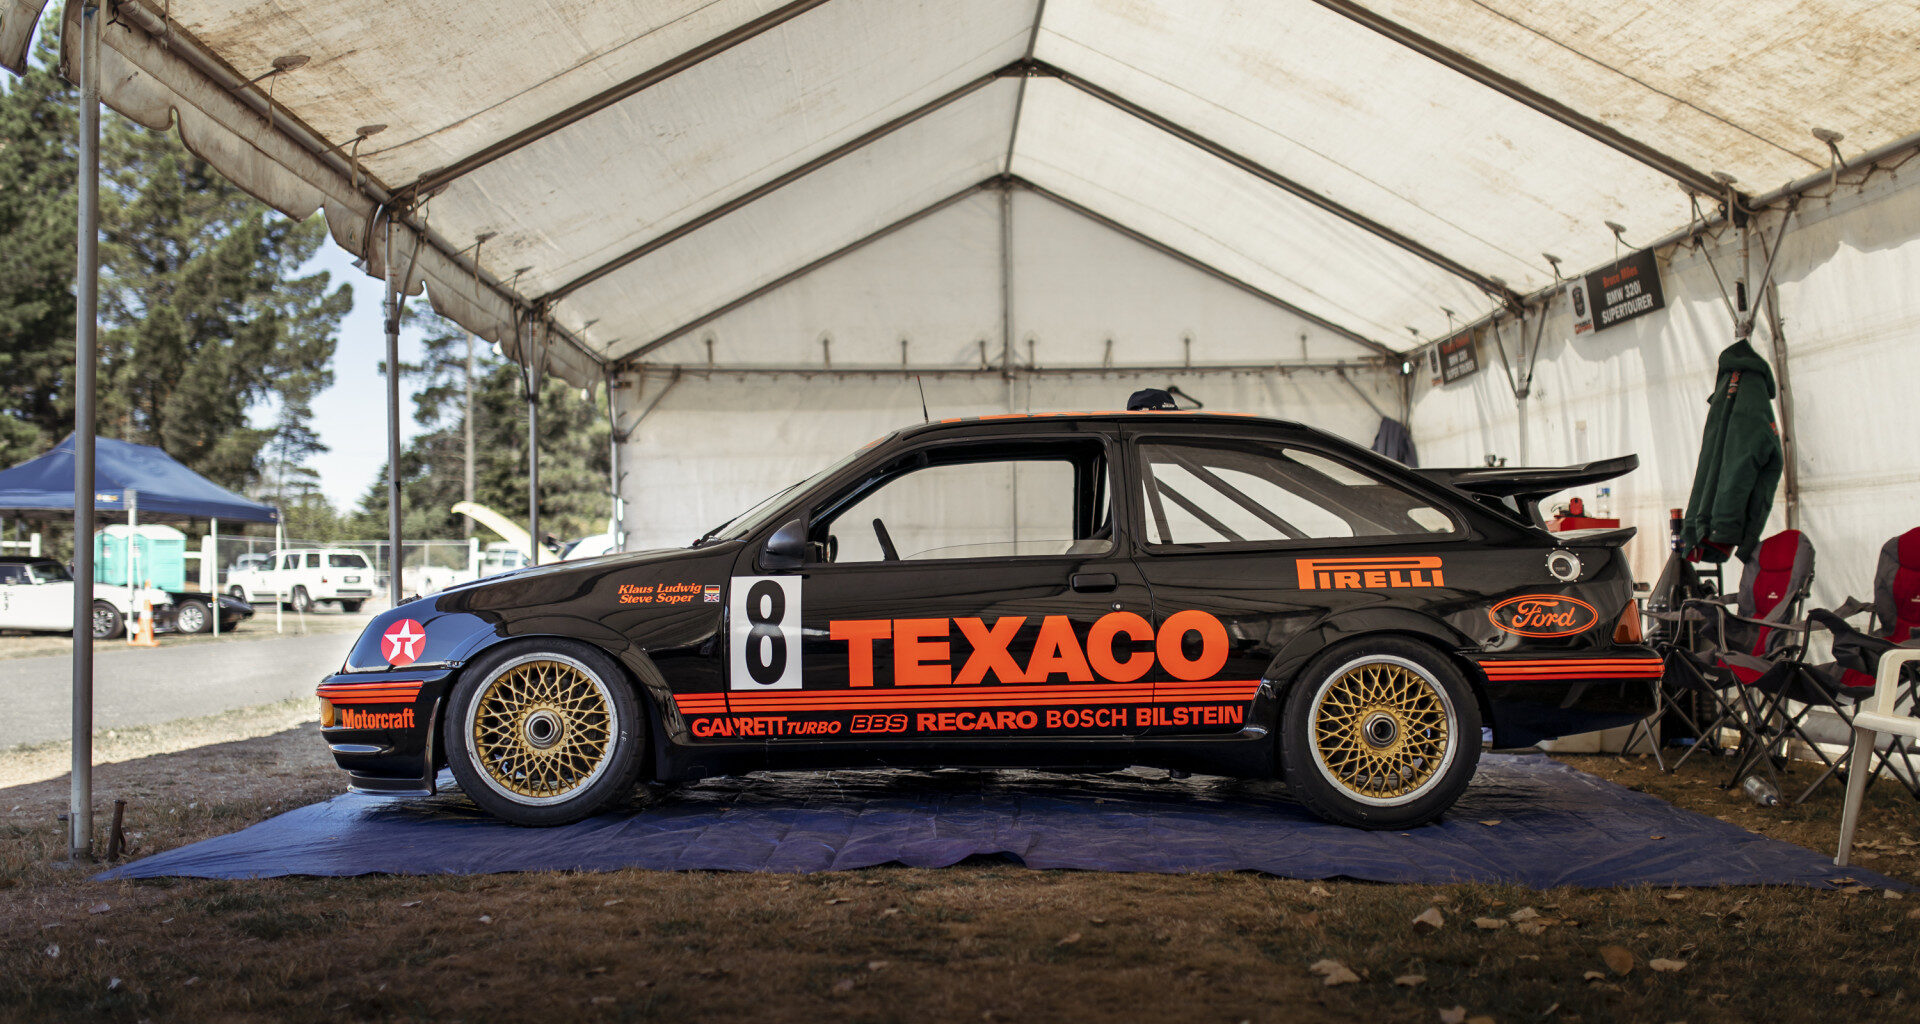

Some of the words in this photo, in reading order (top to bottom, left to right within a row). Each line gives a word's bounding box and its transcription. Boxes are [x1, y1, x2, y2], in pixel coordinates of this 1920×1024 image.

[1601, 293, 1654, 324] SUPERTOURER
[1606, 286, 1624, 306] BMW
[1296, 556, 1445, 590] PIRELLI
[618, 584, 654, 595] Klaus
[656, 582, 702, 595] Ludwig
[619, 593, 653, 604] Steve
[655, 592, 694, 605] Soper
[1512, 600, 1576, 628] Ford
[745, 579, 787, 686] 8
[829, 609, 1229, 687] TEXACO
[341, 707, 415, 729] Motorcraft
[691, 716, 788, 737] GARRETT
[787, 720, 842, 736] TURBO
[850, 714, 909, 733] BBS
[916, 710, 1038, 732] RECARO
[1046, 708, 1128, 729] BOSCH
[1135, 705, 1244, 727] BILSTEIN
